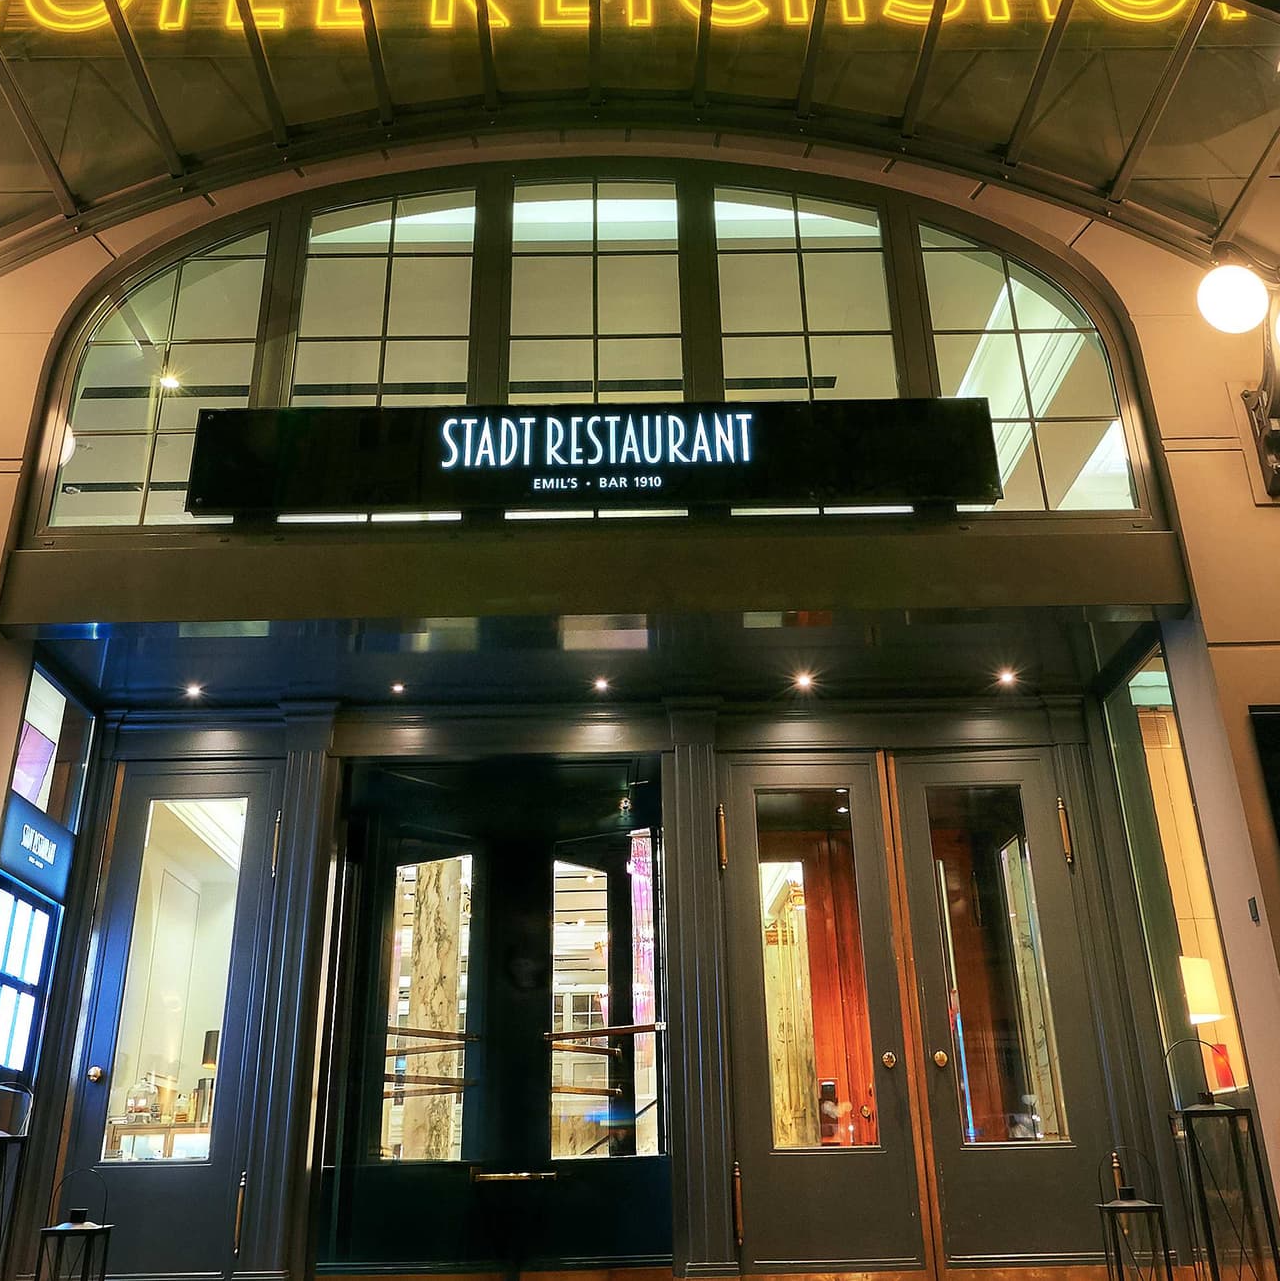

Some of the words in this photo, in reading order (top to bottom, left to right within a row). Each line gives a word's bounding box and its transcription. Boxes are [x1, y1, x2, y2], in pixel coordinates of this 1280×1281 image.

[441, 417, 536, 468] STADT
[546, 412, 752, 466] RESTAURANT
[533, 477, 578, 490] EMIL'S
[599, 476, 628, 489] BAR
[633, 475, 662, 488] 1910
